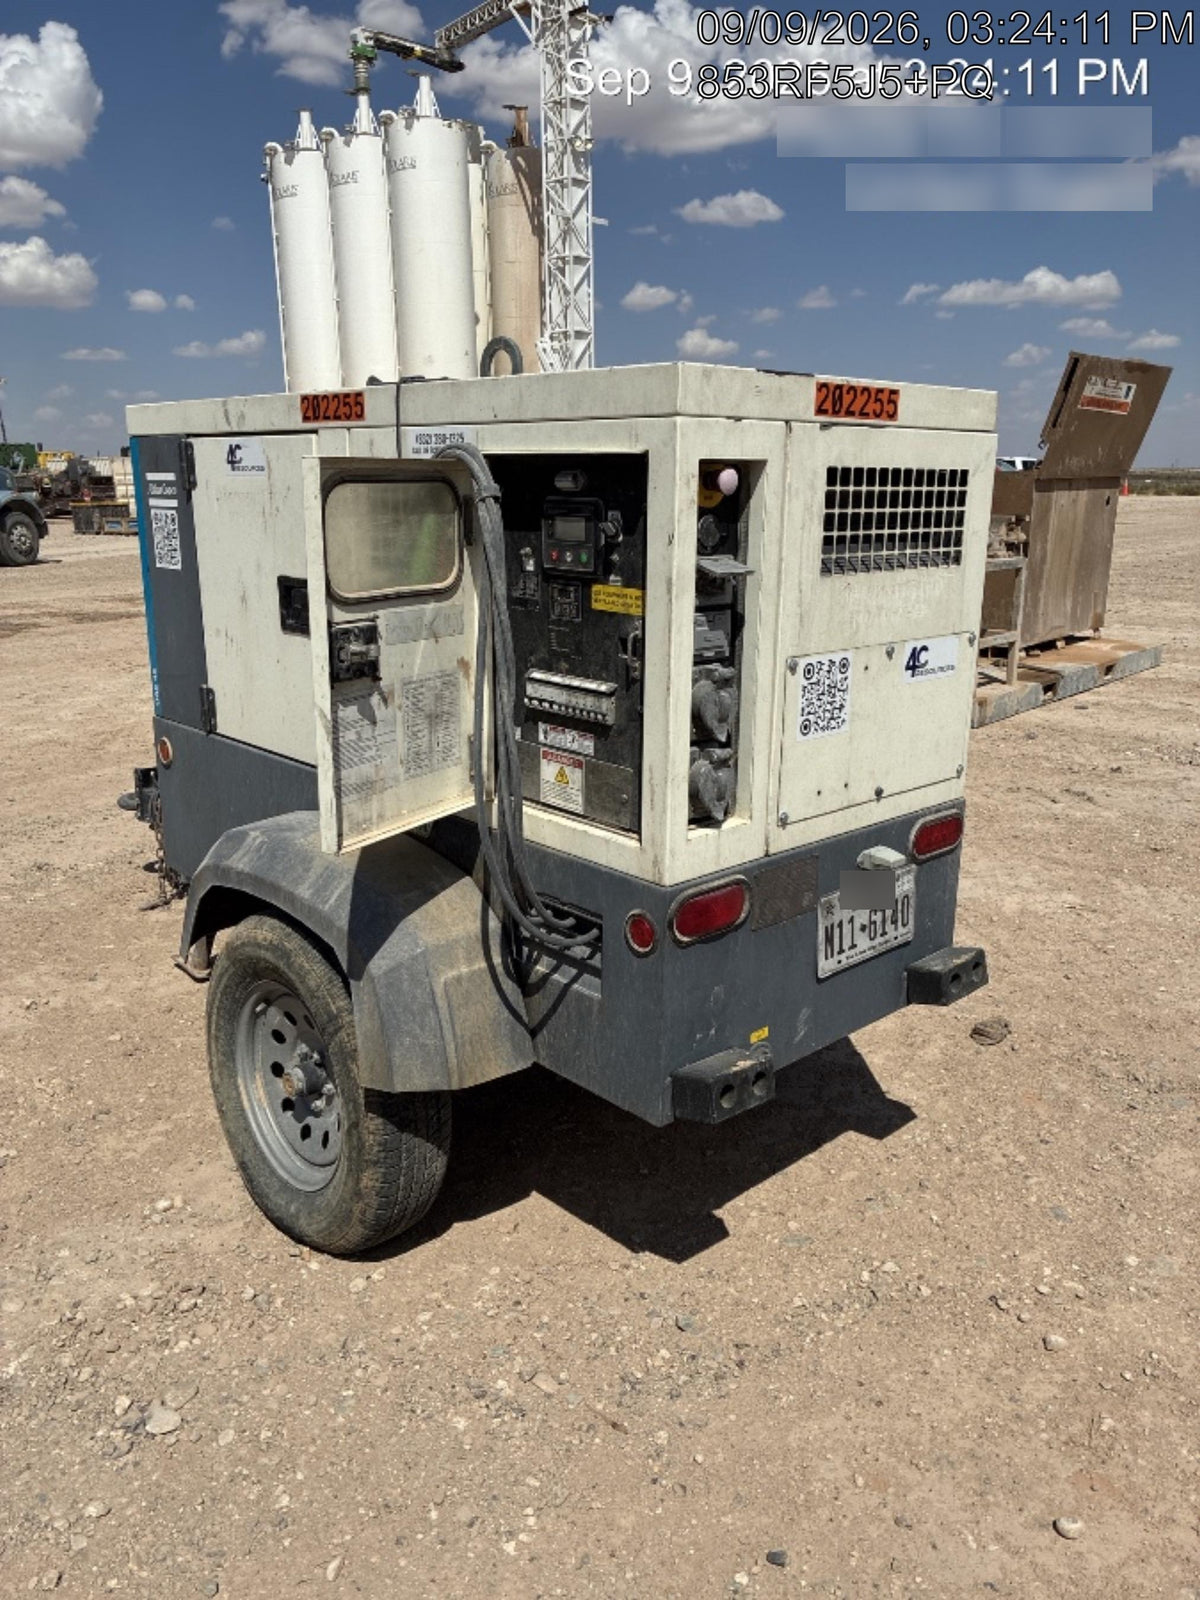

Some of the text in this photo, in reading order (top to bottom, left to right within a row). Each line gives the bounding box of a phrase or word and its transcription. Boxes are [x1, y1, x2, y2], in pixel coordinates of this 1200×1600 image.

[301, 392, 364, 421] 202255
[816, 383, 899, 418] 202255
[227, 444, 243, 471] 4C
[905, 645, 929, 678] 4C
